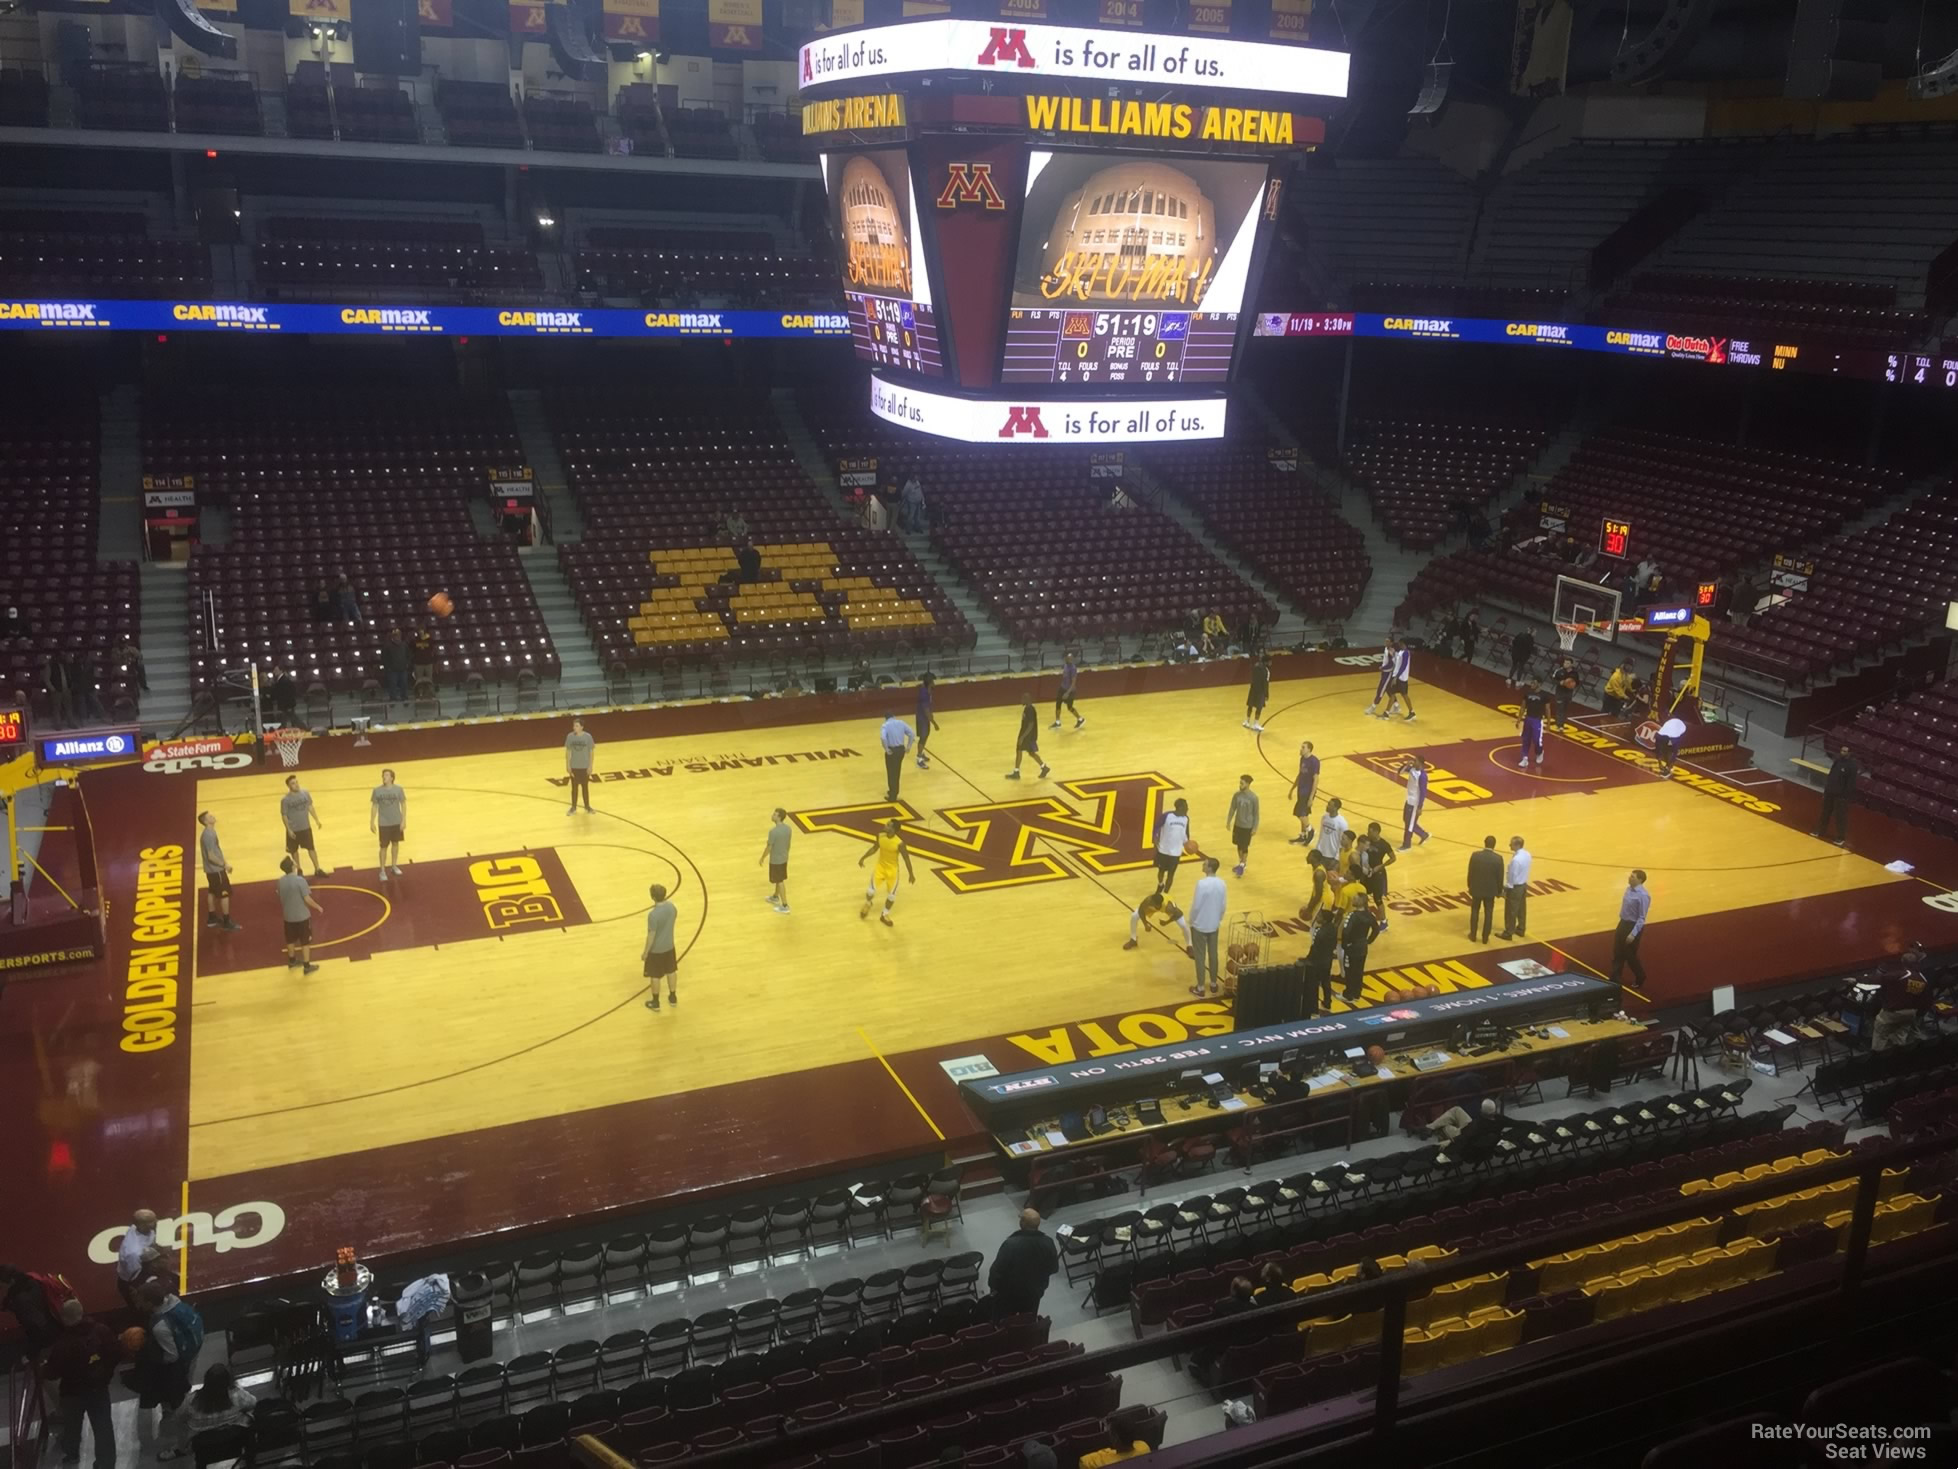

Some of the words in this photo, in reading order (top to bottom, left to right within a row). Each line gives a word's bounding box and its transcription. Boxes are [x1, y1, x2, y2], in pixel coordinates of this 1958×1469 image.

[1195, 8, 1225, 23] 2005
[1276, 14, 1305, 29] 2009
[815, 53, 822, 73] is
[822, 46, 834, 72] for
[837, 44, 849, 71] all
[852, 41, 864, 66] of
[867, 47, 887, 66] us.
[1055, 40, 1074, 66] is
[1083, 39, 1120, 69] for
[1127, 44, 1156, 71] all
[1163, 47, 1189, 74] of
[1194, 58, 1224, 77] us.
[844, 94, 900, 129] ARENA
[1026, 94, 1193, 139] WILLIAMS
[1201, 106, 1294, 145] ARENA
[173, 304, 266, 323] CARmax
[341, 308, 431, 325] CARmax
[499, 310, 581, 328] CARmax
[875, 300, 901, 323] 51:19
[645, 312, 722, 329] CARmax
[1095, 313, 1157, 337] 51:19
[1291, 318, 1313, 331] 11/19
[1384, 317, 1451, 332] CARmax
[1506, 323, 1568, 338] CARmax
[1606, 331, 1660, 348] CARmax
[1666, 335, 1683, 351] Old
[1683, 336, 1710, 354] Dutch
[1731, 341, 1749, 353] FREE
[1077, 341, 1088, 359] 0
[1107, 345, 1135, 359] PRE
[1155, 341, 1166, 359] 0
[1774, 345, 1798, 359] MINN
[1730, 352, 1761, 366] THROWS
[1773, 357, 1785, 370] NU
[1060, 371, 1067, 382] 4
[1083, 371, 1090, 382] 0
[1145, 371, 1152, 382] 0
[1167, 371, 1174, 382] 4
[1914, 368, 1925, 384] 4
[1945, 371, 1956, 387] 0
[897, 397, 908, 418] of
[1065, 414, 1081, 434] is
[1089, 411, 1120, 434] for
[1127, 410, 1149, 433] all
[1156, 410, 1176, 433] of
[1181, 415, 1205, 431] us.
[1606, 522, 1628, 536] 51:19
[1606, 534, 1624, 554] 30
[1699, 593, 1711, 604] 30
[1653, 611, 1678, 621] Allianz
[56, 741, 105, 756] Allianz
[683, 748, 864, 773] WILLIAMS
[131, 845, 184, 942] GOPHERS
[119, 945, 180, 1053] GOLDEN
[1428, 997, 1487, 1012] HOME
[1286, 1022, 1347, 1039] FROM
[1237, 1033, 1285, 1047] NYC
[1113, 1055, 1167, 1070] 28TH
[1170, 1048, 1211, 1061] FEB
[1070, 1067, 1106, 1079] ON
